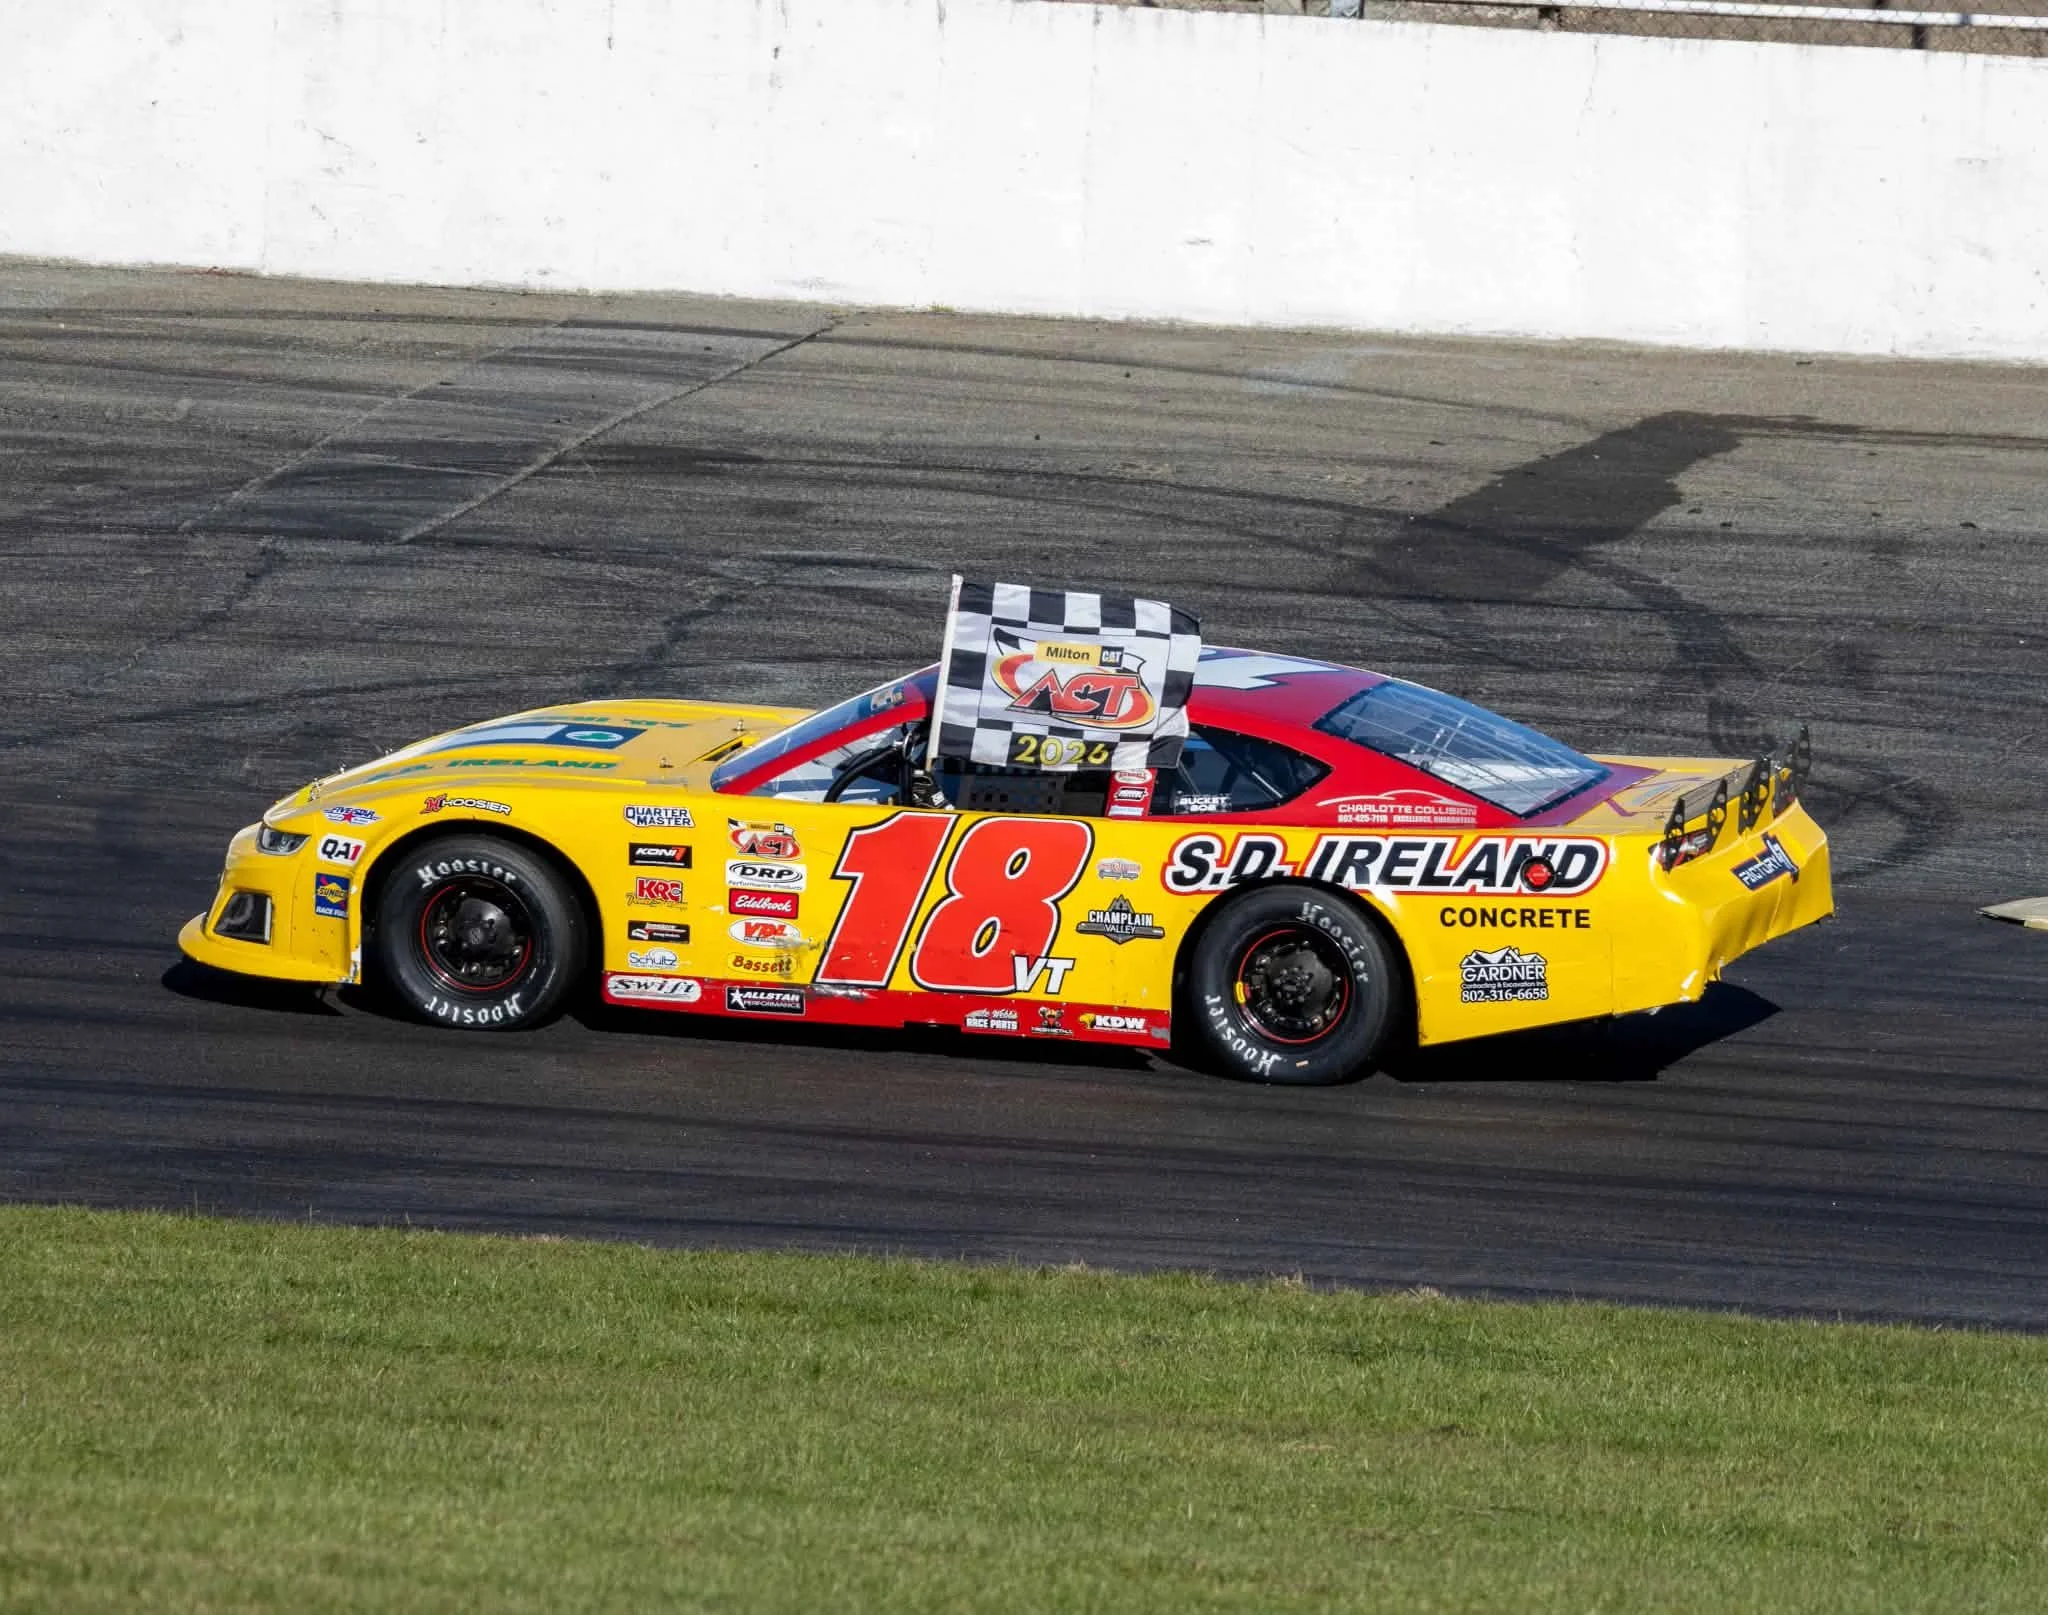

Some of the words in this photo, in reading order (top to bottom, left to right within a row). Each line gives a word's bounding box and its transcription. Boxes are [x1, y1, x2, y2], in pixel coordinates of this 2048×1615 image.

[1045, 646, 1090, 661] Milton
[1101, 650, 1122, 664] CAT
[1006, 668, 1141, 720] ACT
[1014, 735, 1109, 767] 2026
[448, 759, 617, 770] IRELAND
[442, 798, 512, 815] HOOSIER
[625, 806, 688, 820] QUARTER
[1338, 804, 1412, 814] CHARLOTTE
[1414, 805, 1477, 816] COLLISION
[636, 816, 691, 826] MASTER
[322, 838, 362, 860] QA1
[417, 859, 516, 889] Hoosier
[739, 865, 794, 879] DRP
[1170, 839, 1285, 888] S.D.
[1311, 840, 1600, 892] IRELAND
[637, 879, 682, 903] KRC
[735, 895, 793, 912] Edelbrock
[811, 810, 1095, 995] 18
[1089, 910, 1153, 927] CHAMPLAIN
[1439, 907, 1591, 929] CONCRETE
[1104, 924, 1136, 935] VALLEY
[1296, 901, 1369, 982] Hoosier
[732, 955, 792, 973] Bassett
[1012, 955, 1076, 994] VT
[1461, 965, 1546, 983] GARDNER
[608, 979, 695, 994] Swift
[1461, 987, 1548, 1002] 802-316-6658
[742, 991, 801, 1002] ALLSTAR
[743, 1000, 801, 1009] PERFORMANCE
[423, 993, 524, 1025] Hoosier
[1095, 1014, 1146, 1030] KDW
[1204, 994, 1283, 1076] Hoosier
